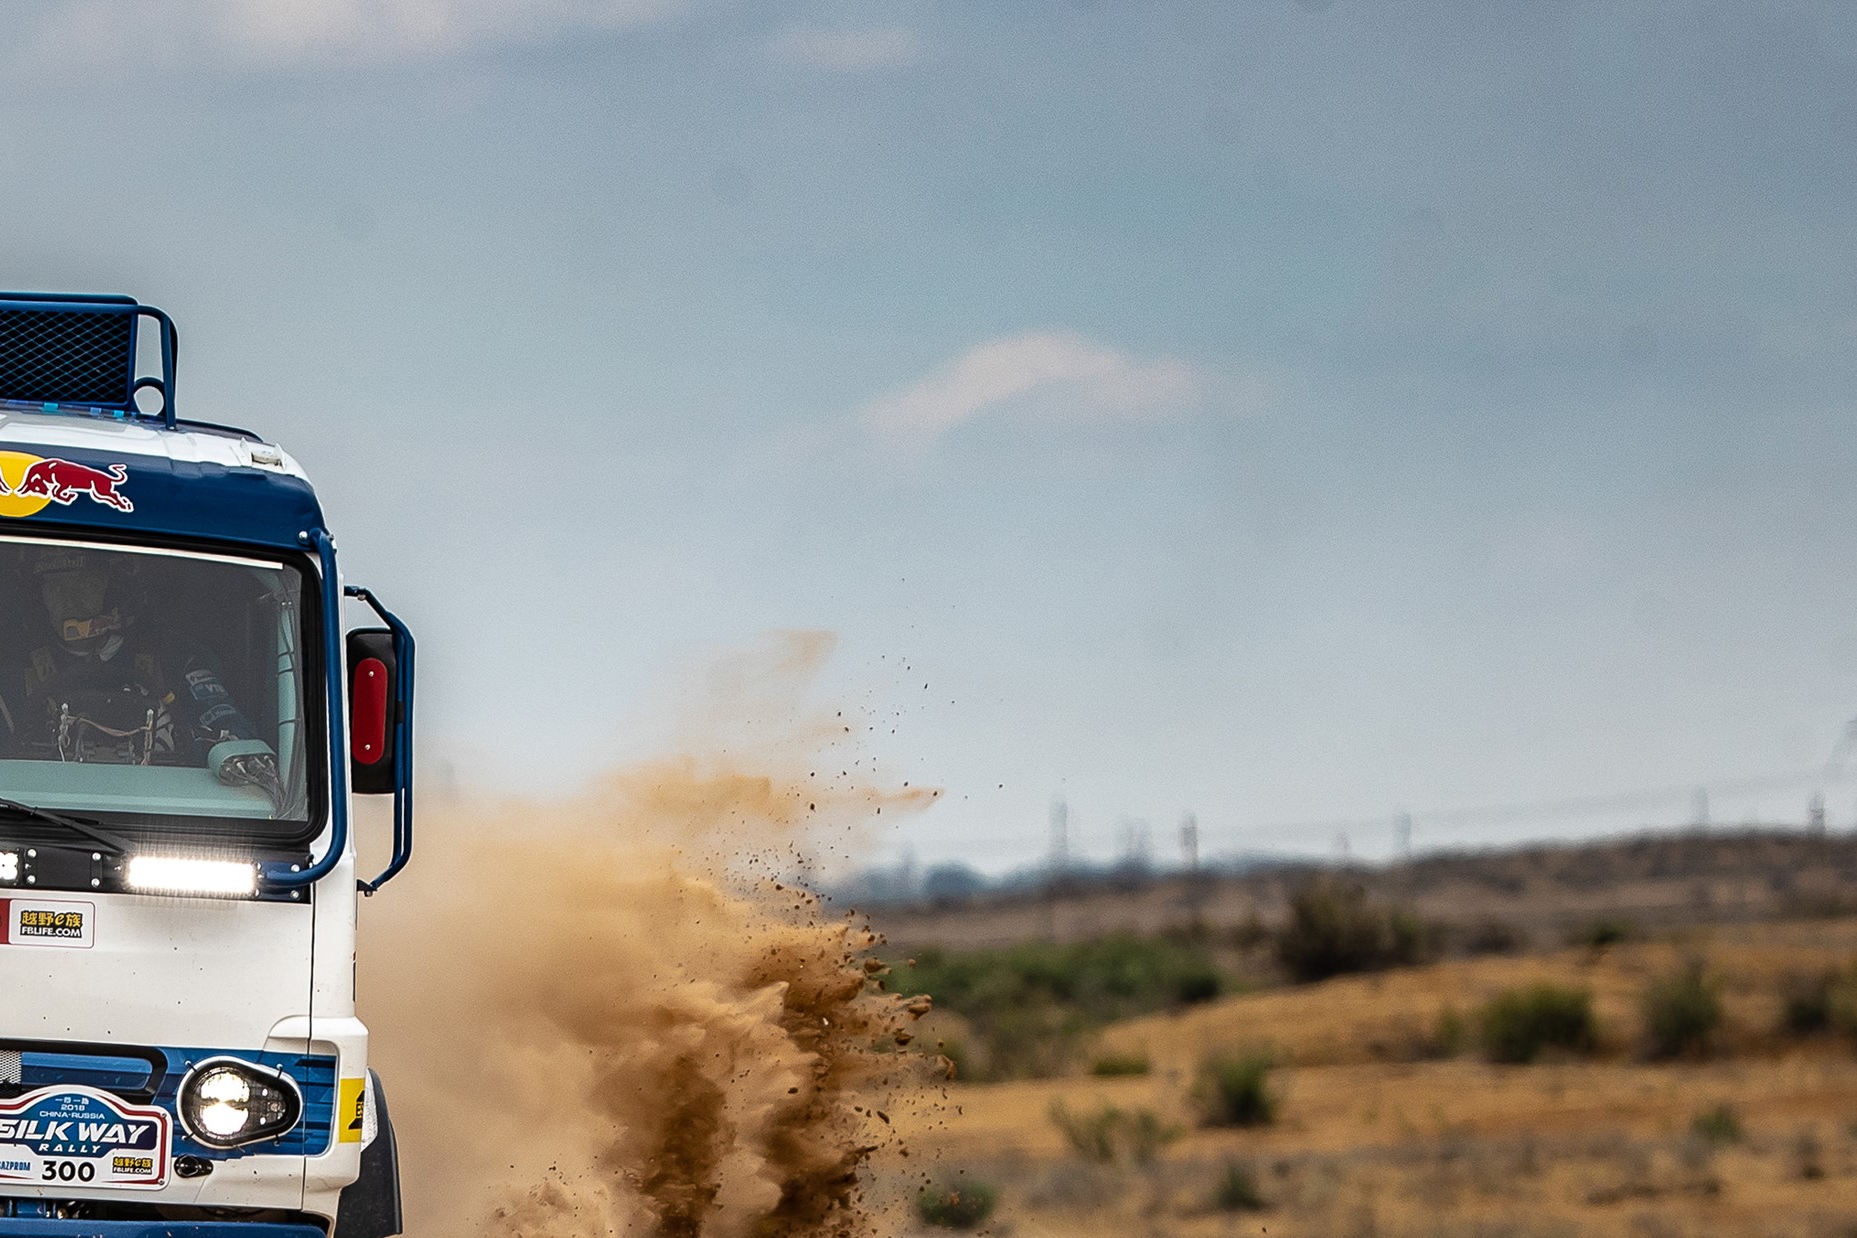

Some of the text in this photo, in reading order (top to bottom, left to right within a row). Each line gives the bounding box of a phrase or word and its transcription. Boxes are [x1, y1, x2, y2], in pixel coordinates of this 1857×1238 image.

[21, 926, 81, 937] FBLIFE.COM
[78, 1121, 150, 1144] WAY
[38, 1143, 101, 1154] RALLY
[41, 1160, 96, 1182] 300
